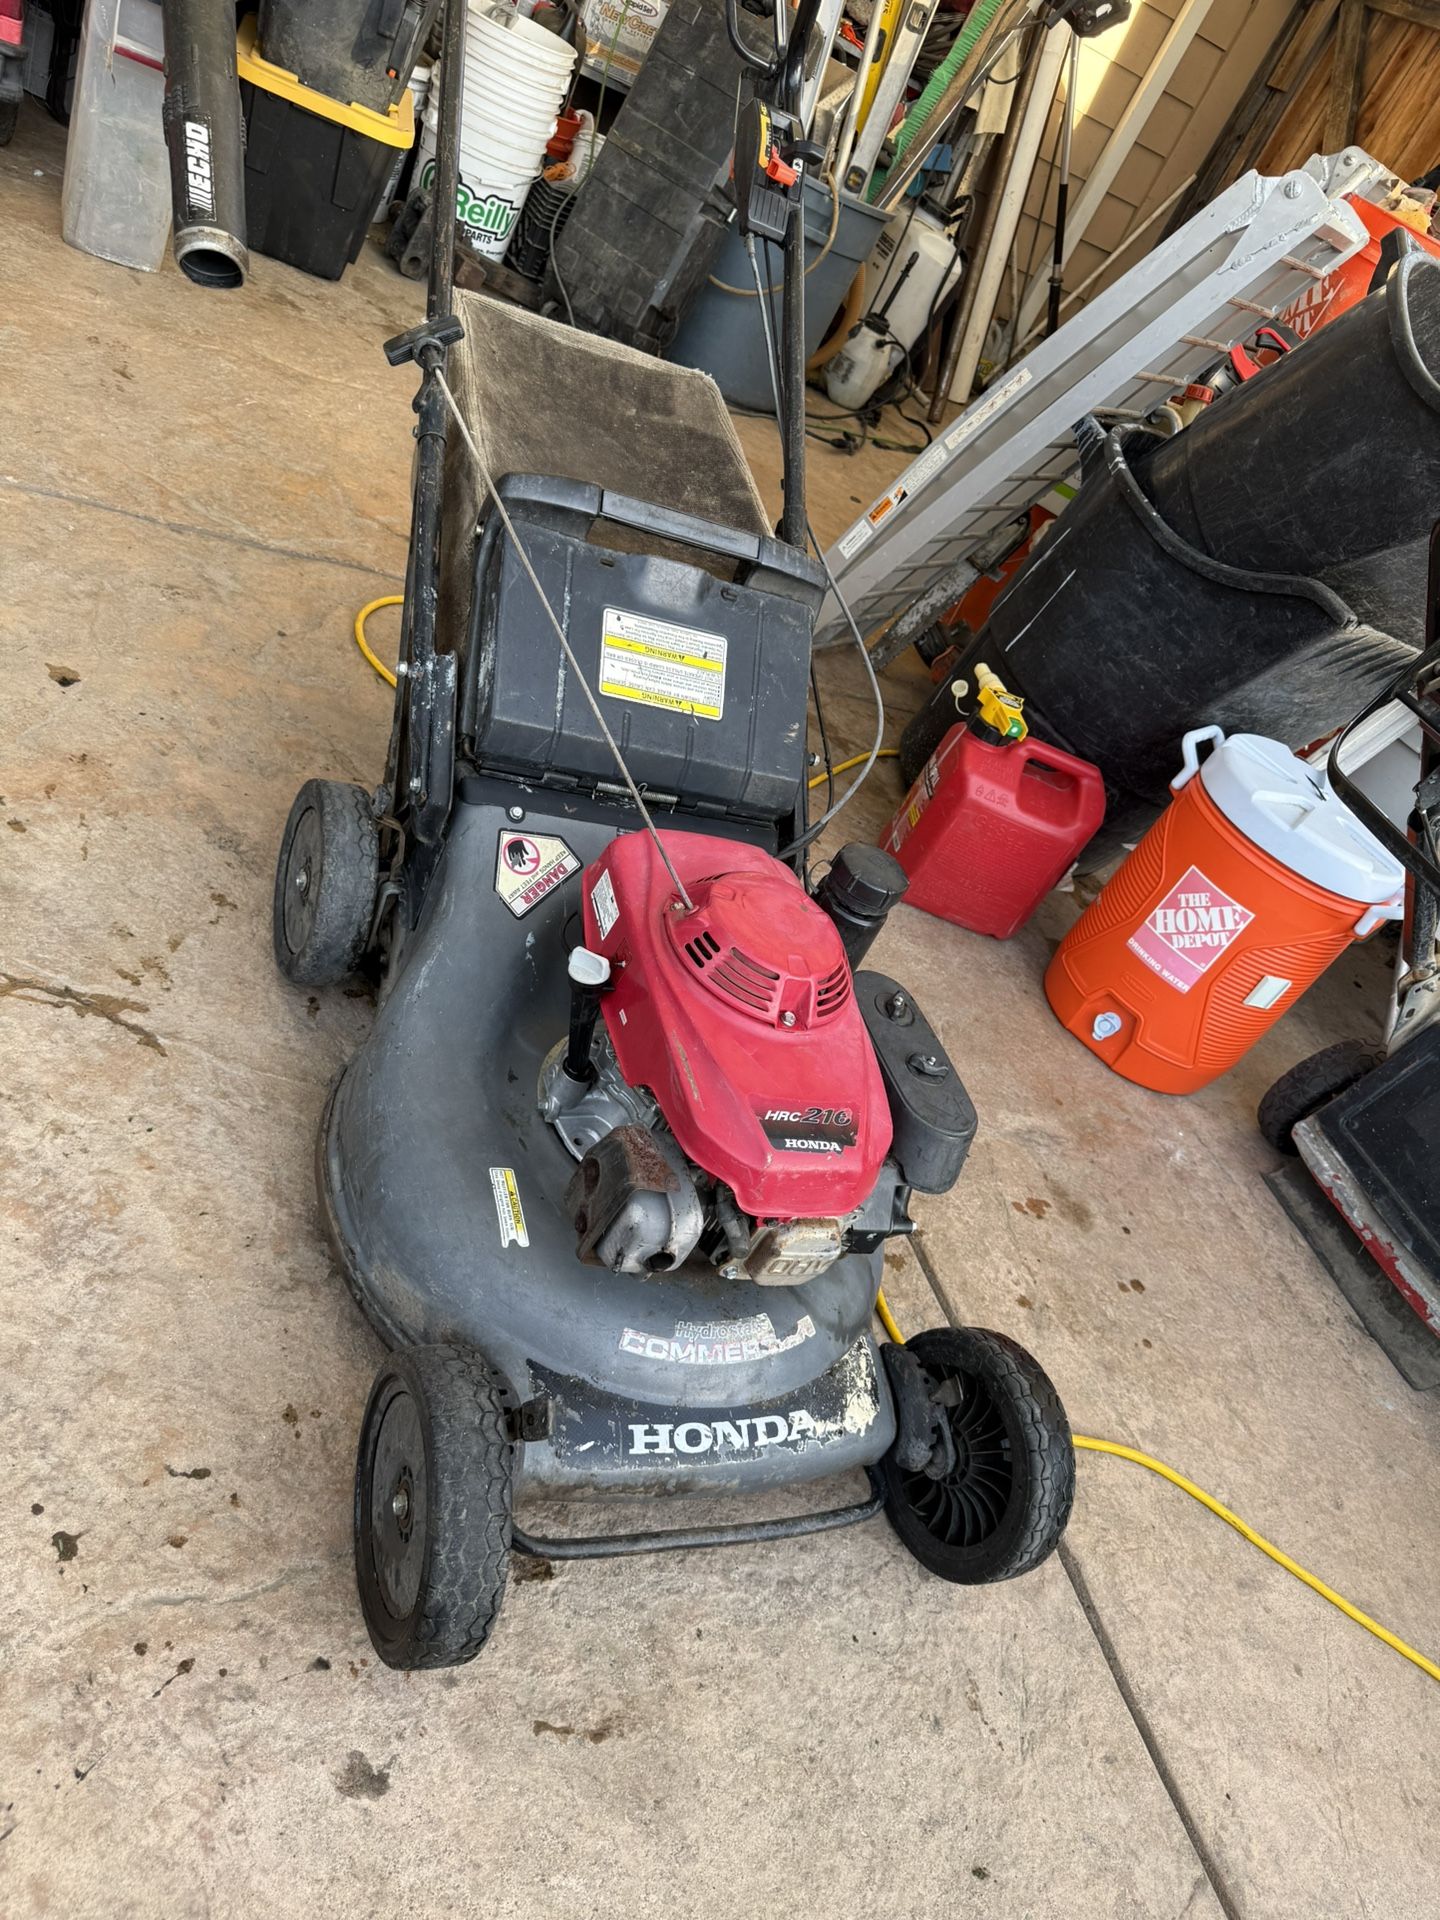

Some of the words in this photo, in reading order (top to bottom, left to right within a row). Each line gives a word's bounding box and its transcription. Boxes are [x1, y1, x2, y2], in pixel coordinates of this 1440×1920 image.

[186, 121, 211, 194] ECHO
[423, 163, 516, 237] Reilly
[645, 646, 677, 660] WARNING
[641, 692, 675, 705] WARNING
[553, 850, 566, 861] KEEP
[538, 859, 555, 873] HANDS
[519, 877, 532, 889] FEET
[520, 862, 568, 905] DANGER
[1177, 892, 1211, 907] THE
[1155, 905, 1245, 933] HOME
[1171, 931, 1230, 949] DEPOT
[1127, 937, 1162, 970] DRINKING
[1161, 968, 1190, 993] WATER
[784, 1138, 841, 1151] HONDA
[510, 1197, 522, 1224] CAUTION
[628, 1409, 817, 1455] HONDA
